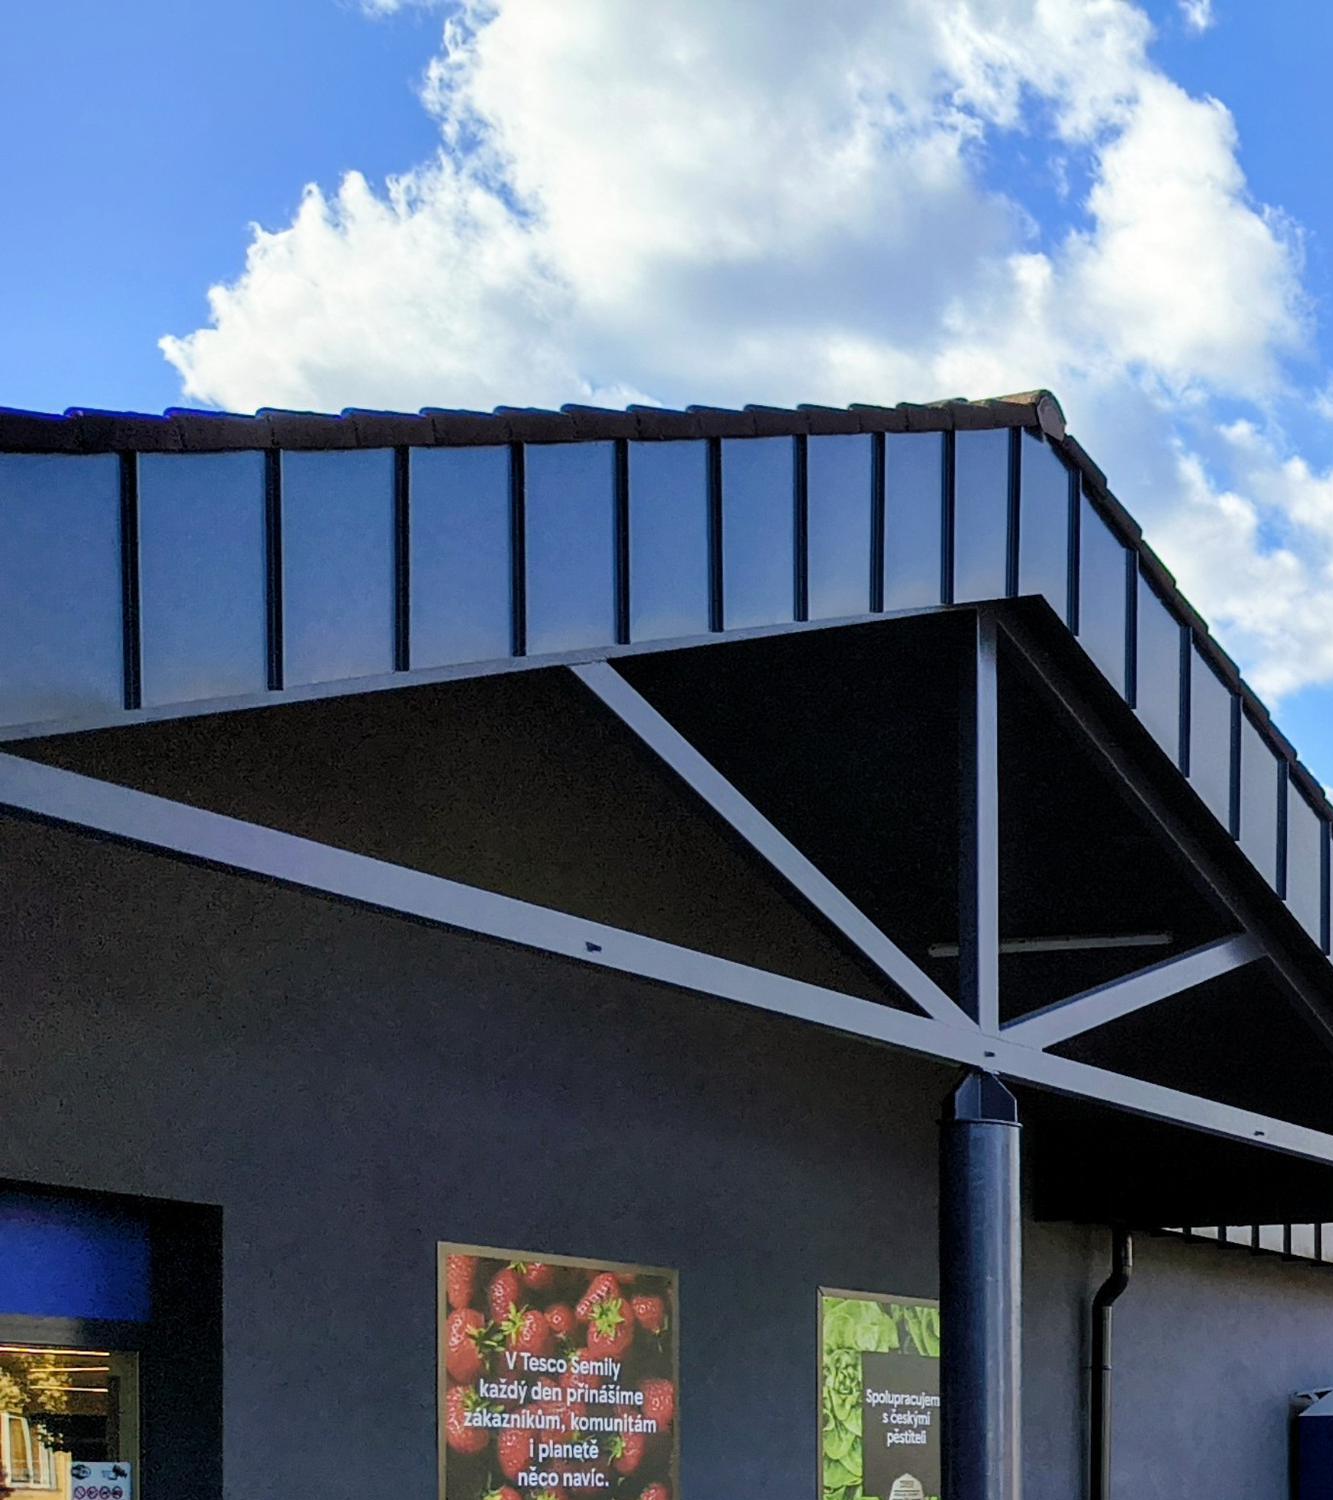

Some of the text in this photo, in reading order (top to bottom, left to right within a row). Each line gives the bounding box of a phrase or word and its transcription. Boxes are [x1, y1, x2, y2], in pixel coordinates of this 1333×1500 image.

[505, 1352, 621, 1381] V Tesco Semily
[479, 1379, 644, 1407] každý den přinášíme
[866, 1388, 940, 1409] Spolupracujem
[463, 1408, 657, 1433] zákazníkům, komunitám
[882, 1409, 931, 1428] s českými
[887, 1428, 927, 1447] pěstiteli
[529, 1439, 599, 1463] i planetě
[518, 1466, 610, 1487] něco navíc.
